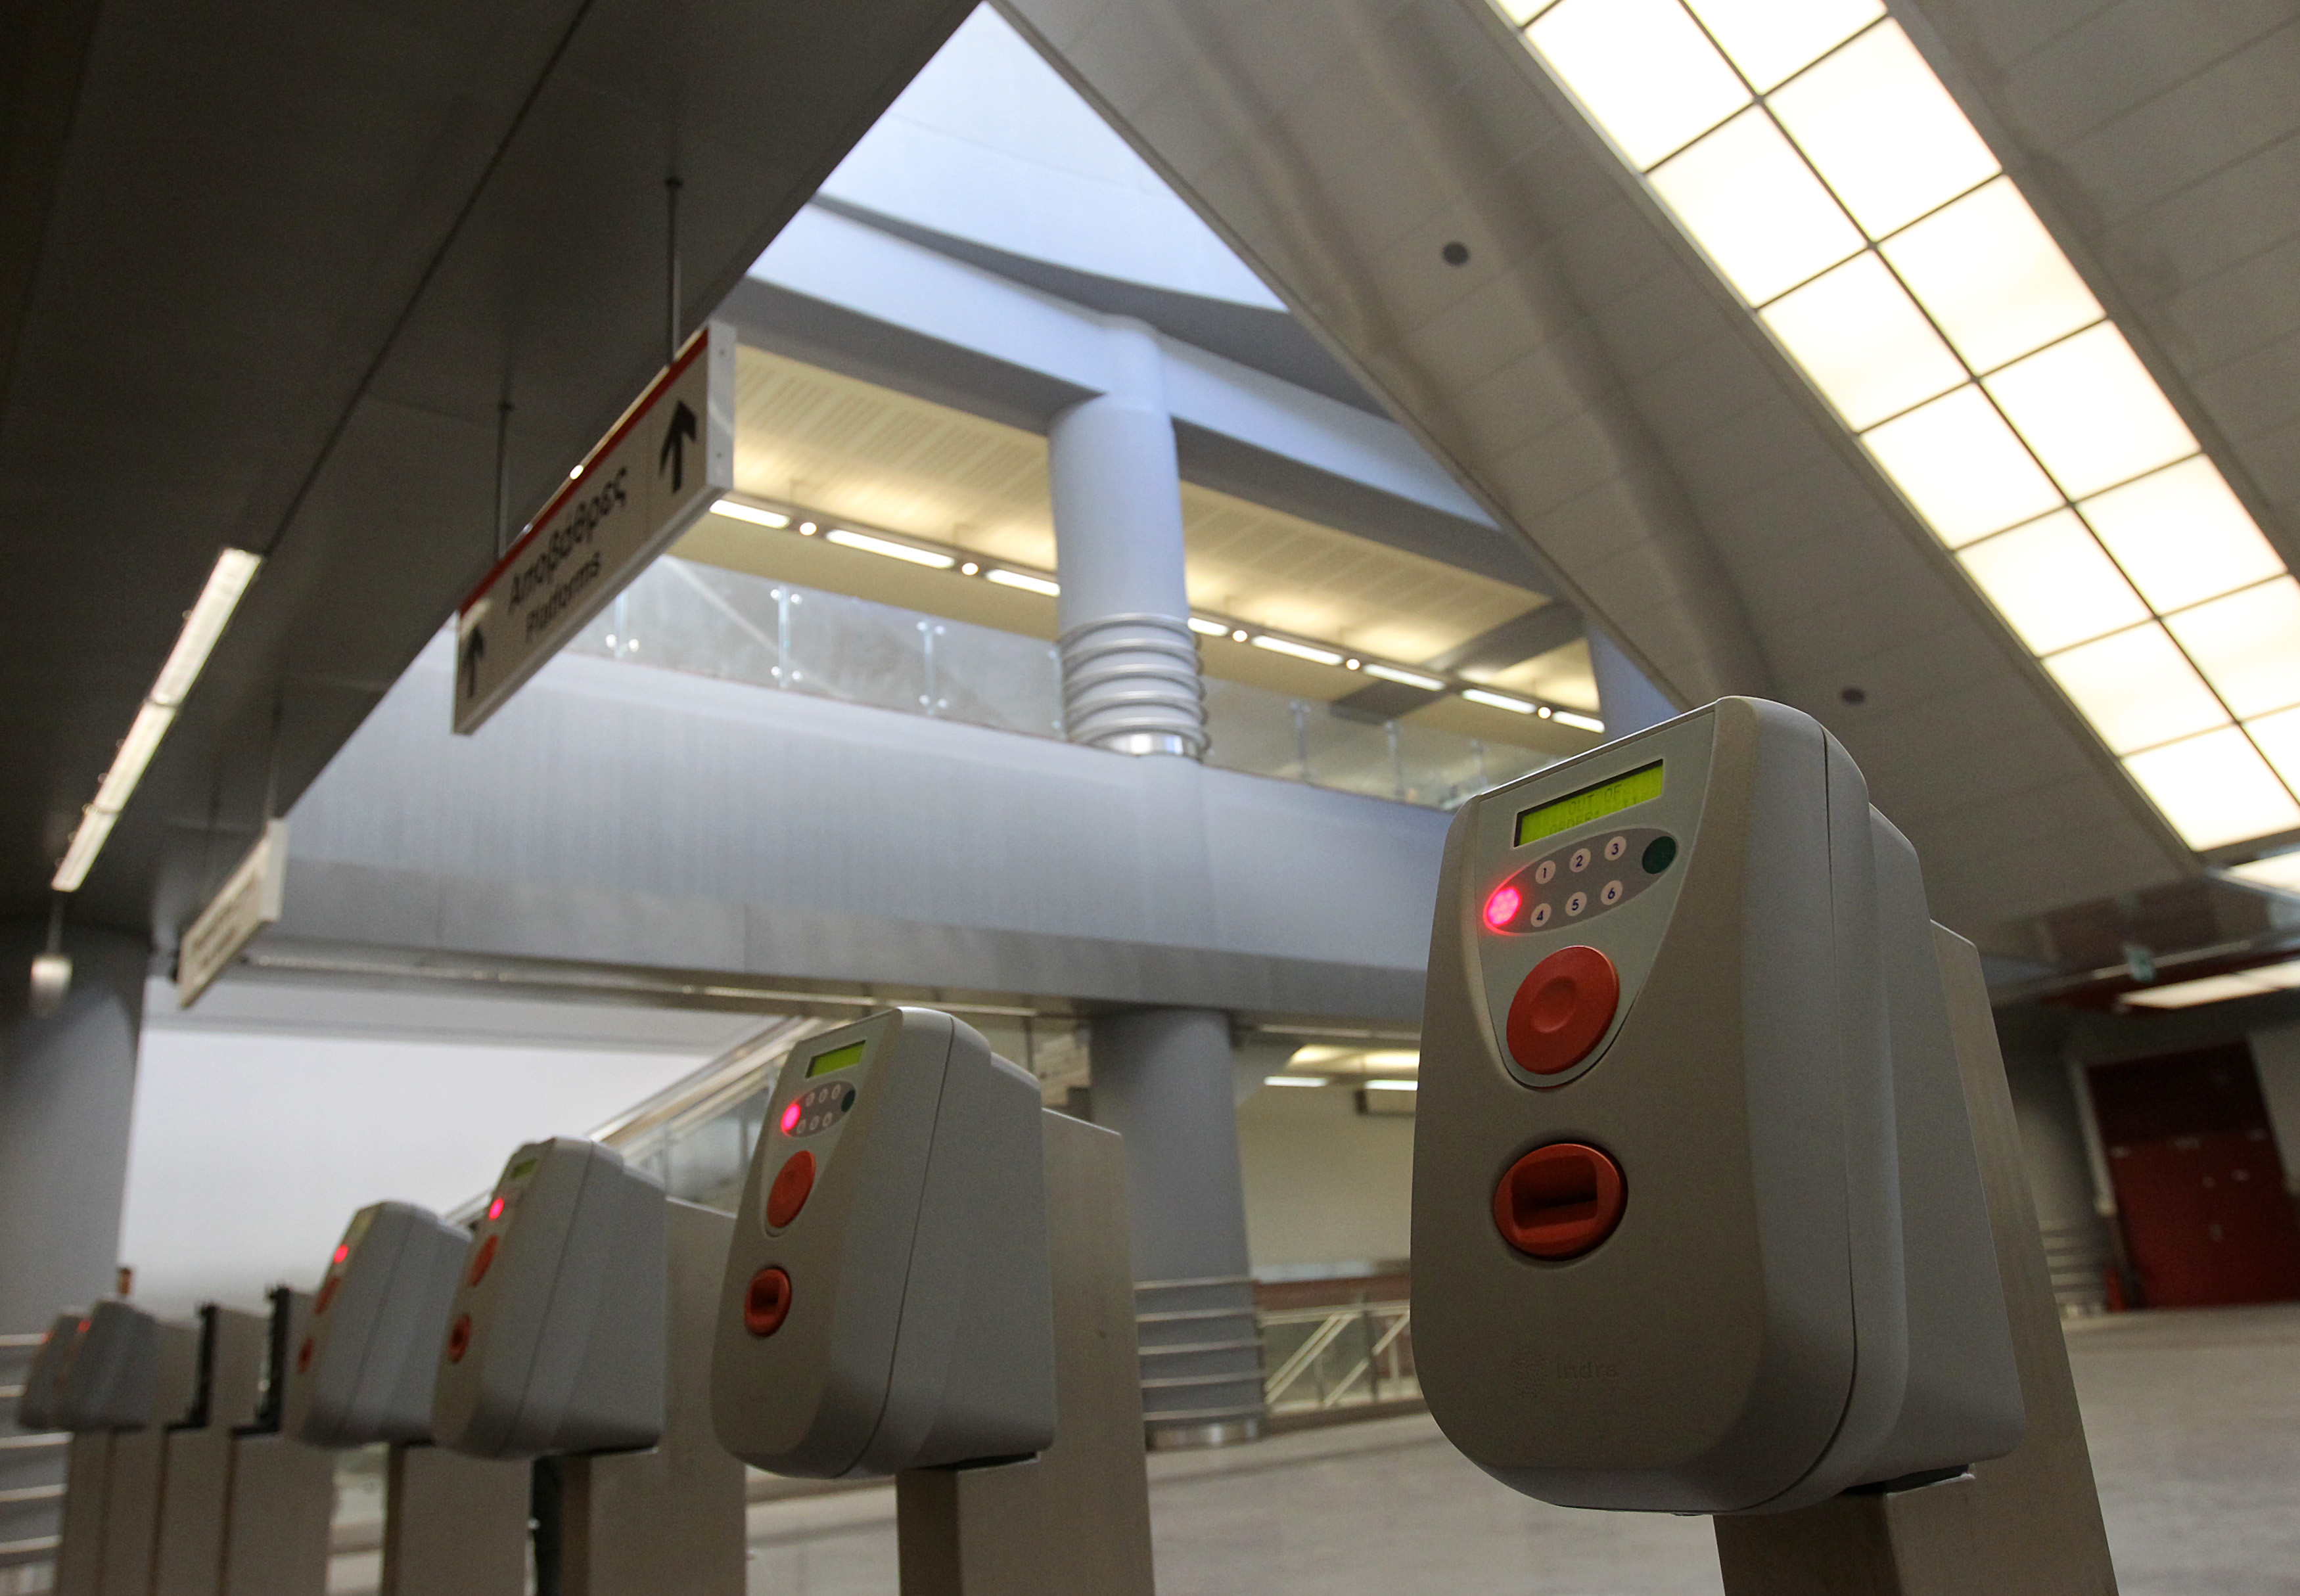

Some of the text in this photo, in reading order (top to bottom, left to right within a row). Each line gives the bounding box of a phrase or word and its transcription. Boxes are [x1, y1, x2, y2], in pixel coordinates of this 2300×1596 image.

[1569, 783, 1622, 815] OUT OF
[1575, 855, 1584, 867] 2
[1611, 843, 1619, 855] 3
[1536, 888, 1615, 921] 4 5 6
